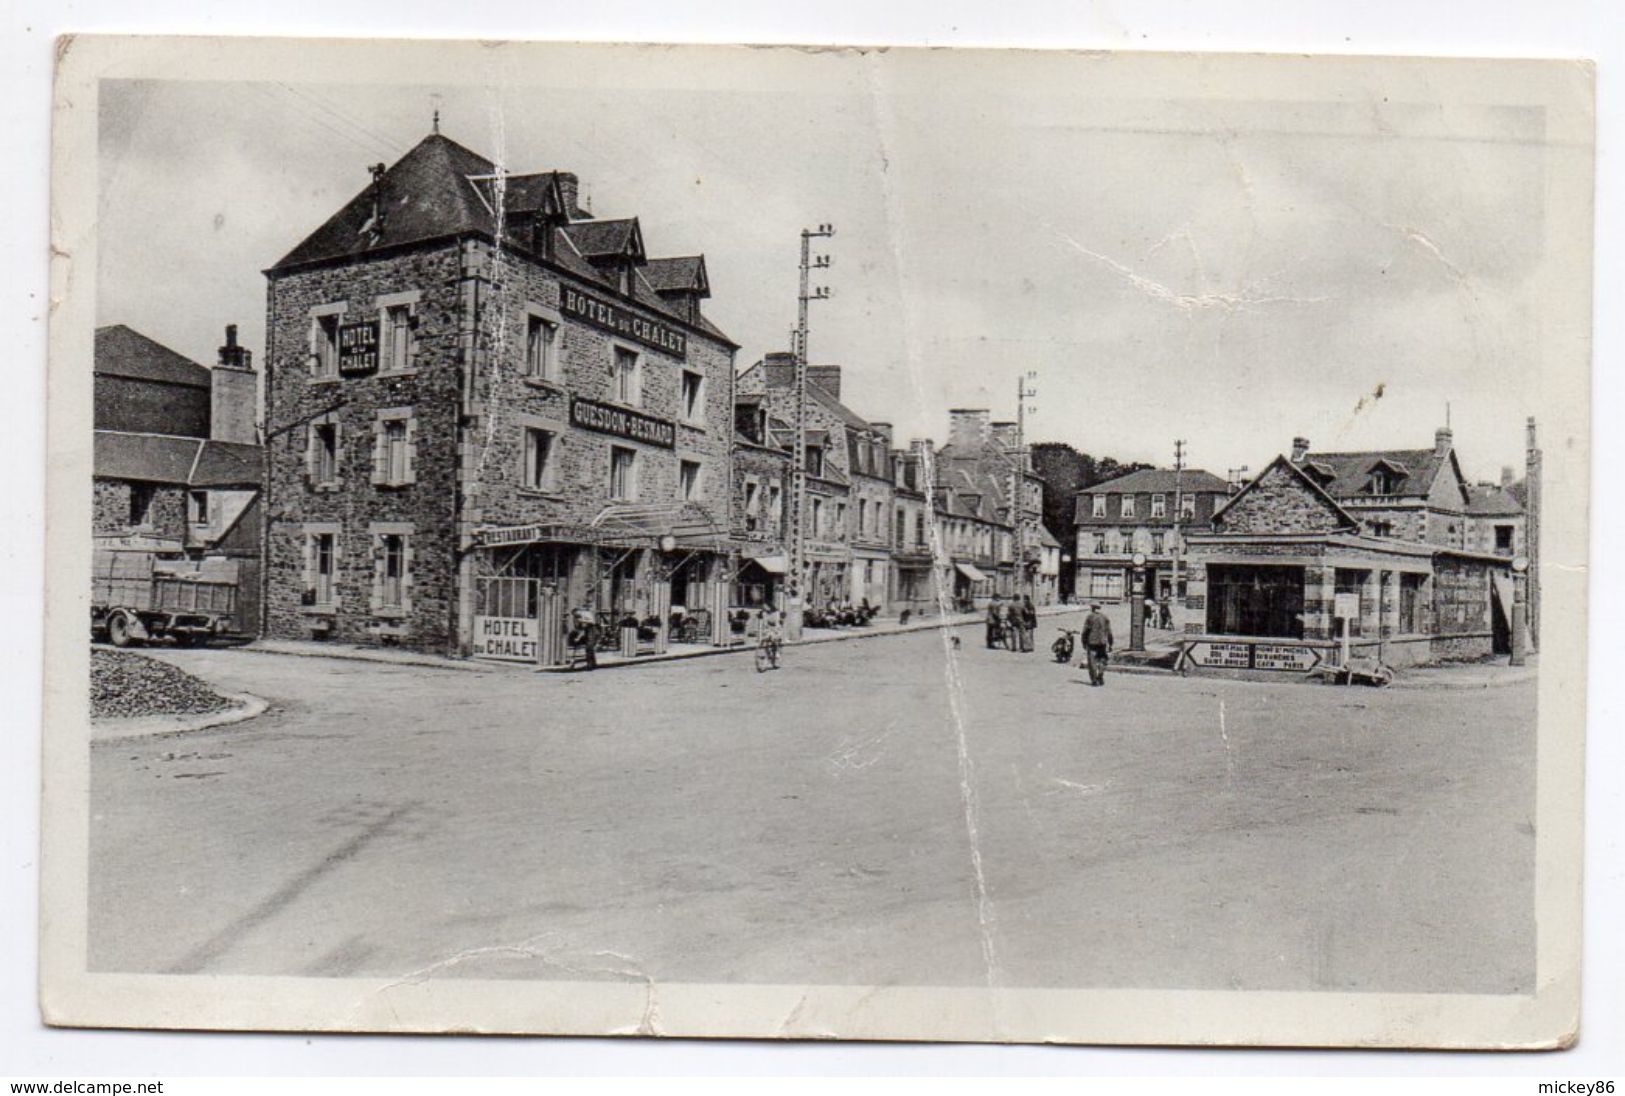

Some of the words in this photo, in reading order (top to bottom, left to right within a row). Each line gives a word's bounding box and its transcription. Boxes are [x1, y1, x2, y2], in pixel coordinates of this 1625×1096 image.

[566, 289, 615, 328] HOTEL
[633, 319, 684, 352] CHALET
[342, 326, 375, 347] HOTEL
[341, 352, 376, 371] CHALET
[484, 619, 529, 637] HOTEL
[487, 639, 537, 657] CHALET
